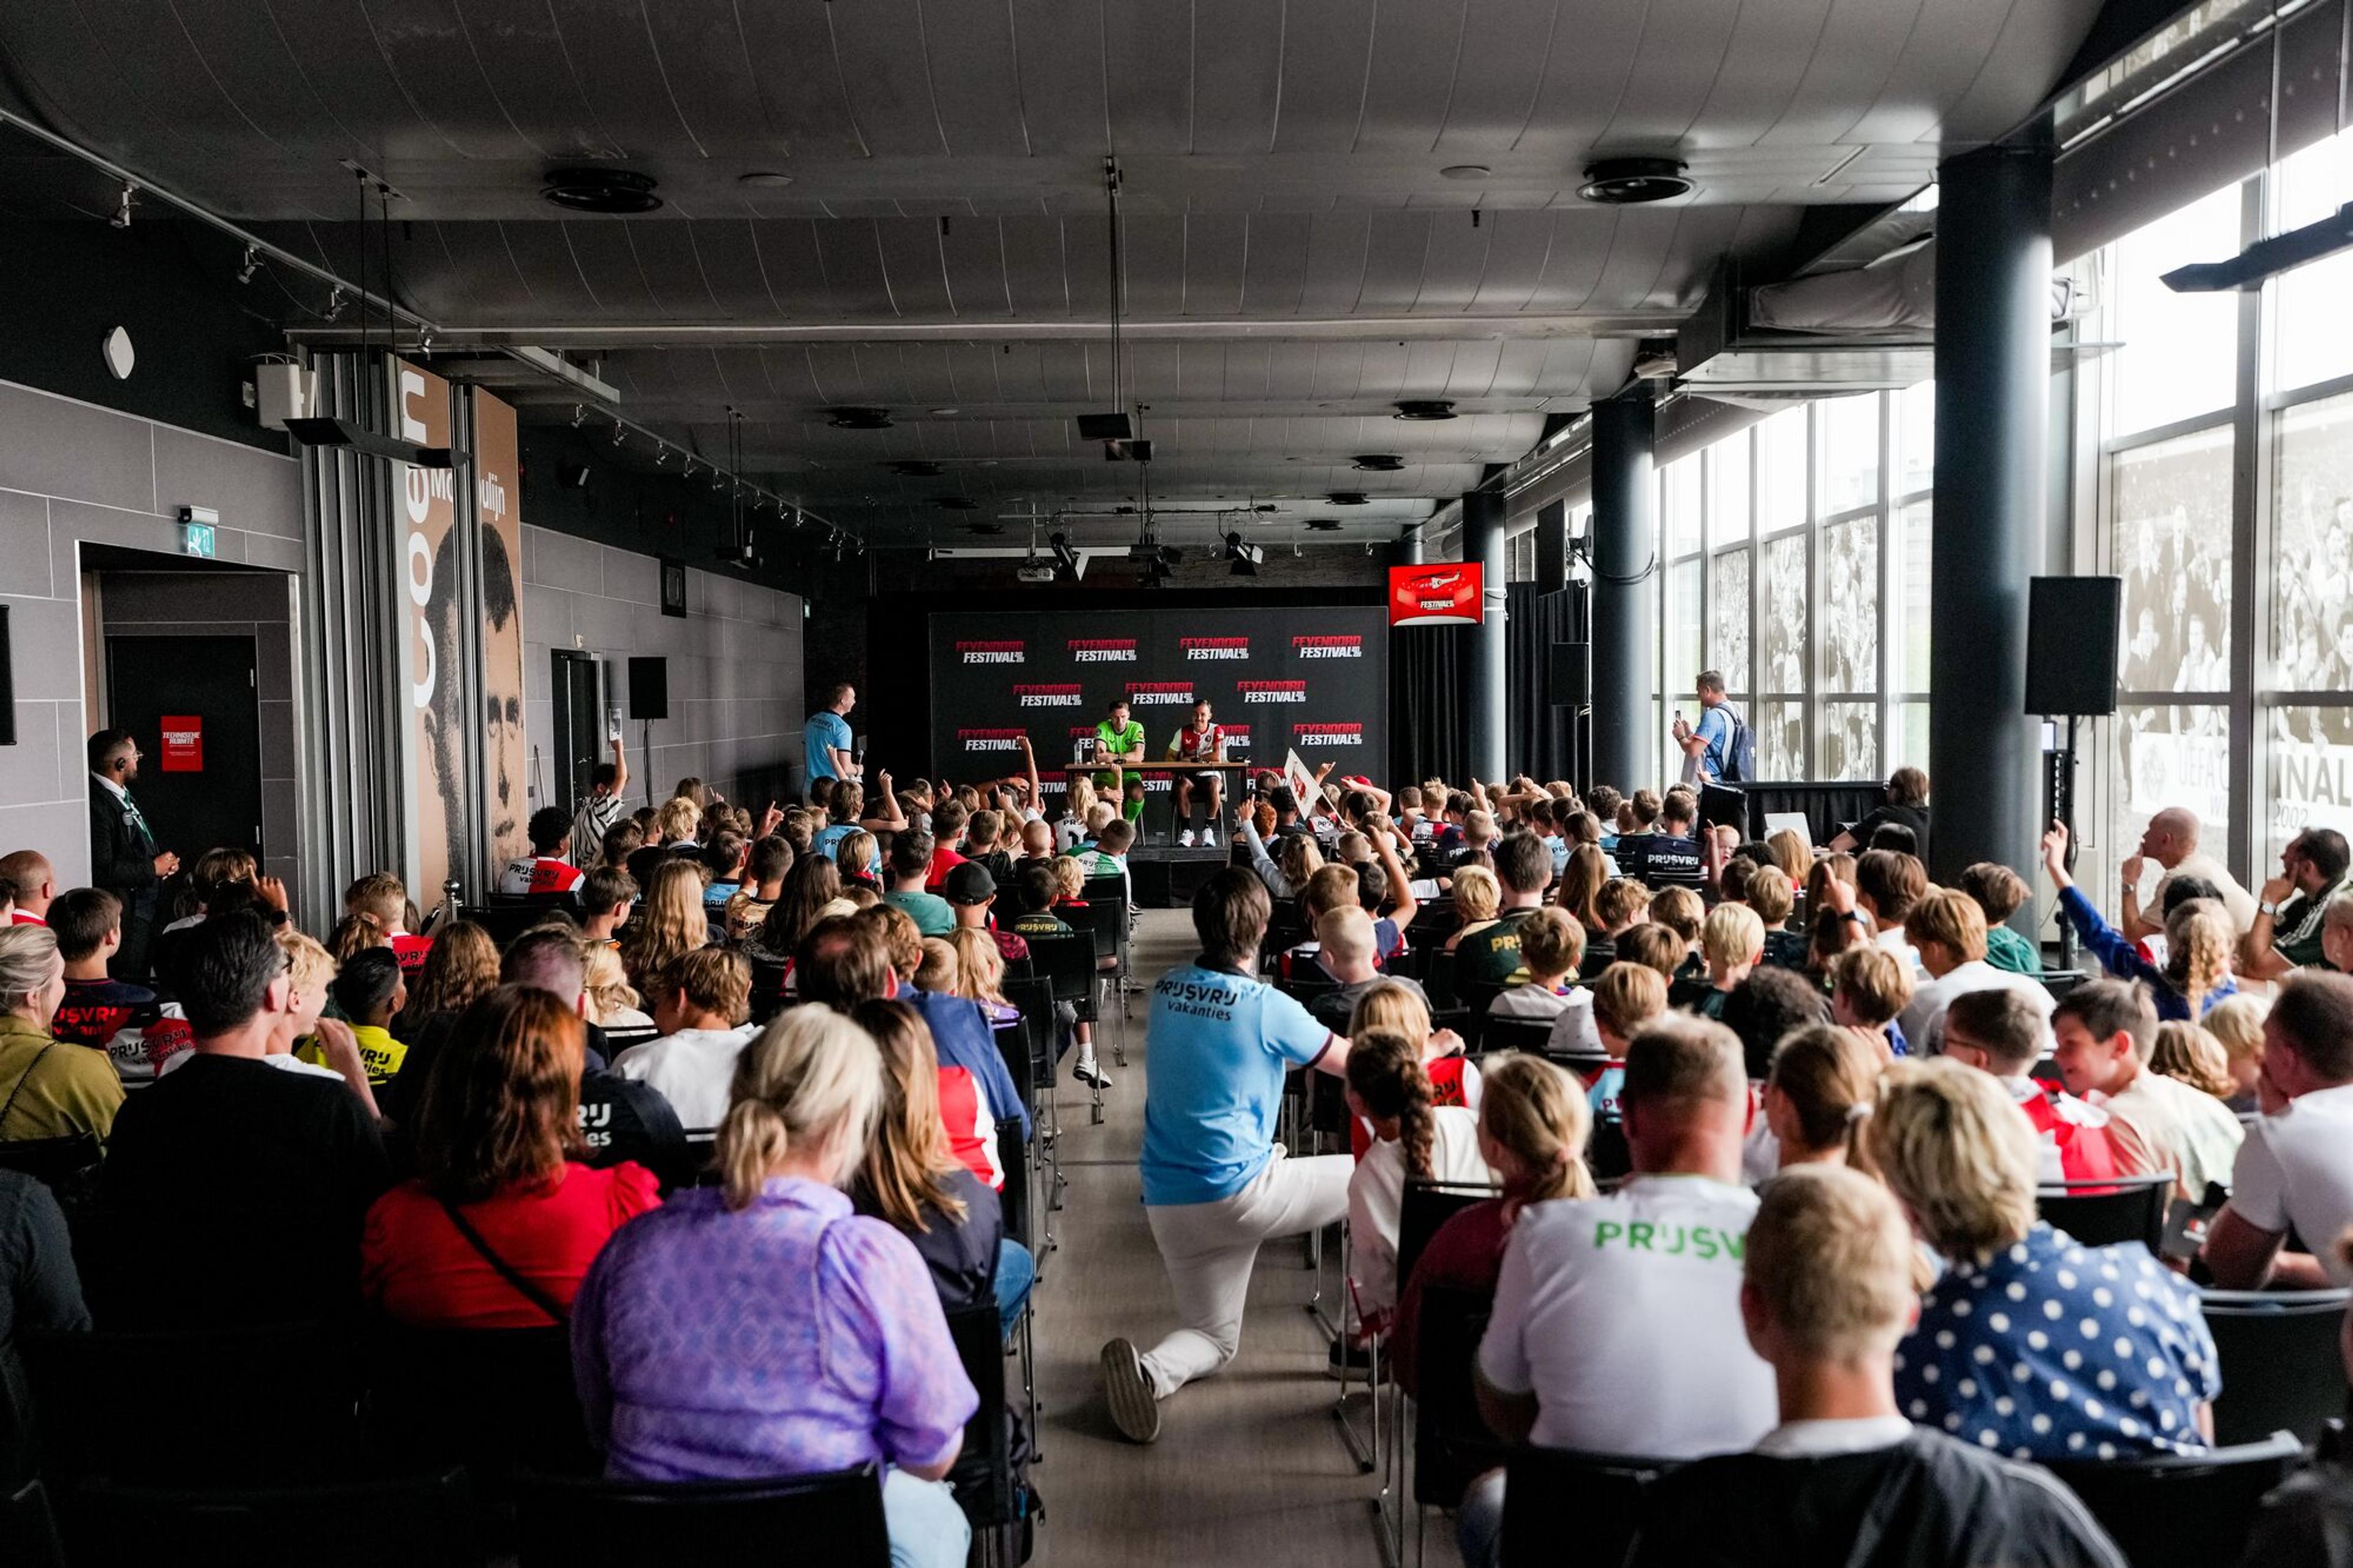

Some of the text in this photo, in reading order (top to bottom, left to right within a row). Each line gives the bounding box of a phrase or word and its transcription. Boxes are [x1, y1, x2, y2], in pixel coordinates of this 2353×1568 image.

[963, 652, 1014, 663] FESTIVAL
[1075, 650, 1127, 661] FESTIVAL
[1187, 648, 1239, 659] FESTIVAL
[1299, 647, 1352, 658] FESTIVAL
[1020, 695, 1072, 706] FESTIVAL
[1132, 693, 1184, 704] FESTIVAL
[1244, 692, 1296, 703] FESTIVAL
[1300, 735, 1353, 745] FESTIVAL
[2275, 754, 2352, 808] INAL
[1038, 782, 1067, 793] STIVA
[1155, 980, 1237, 1006] PRIJSVRIJ
[1168, 1001, 1231, 1021] vakanties
[1594, 1222, 1746, 1262] PRIJSV
